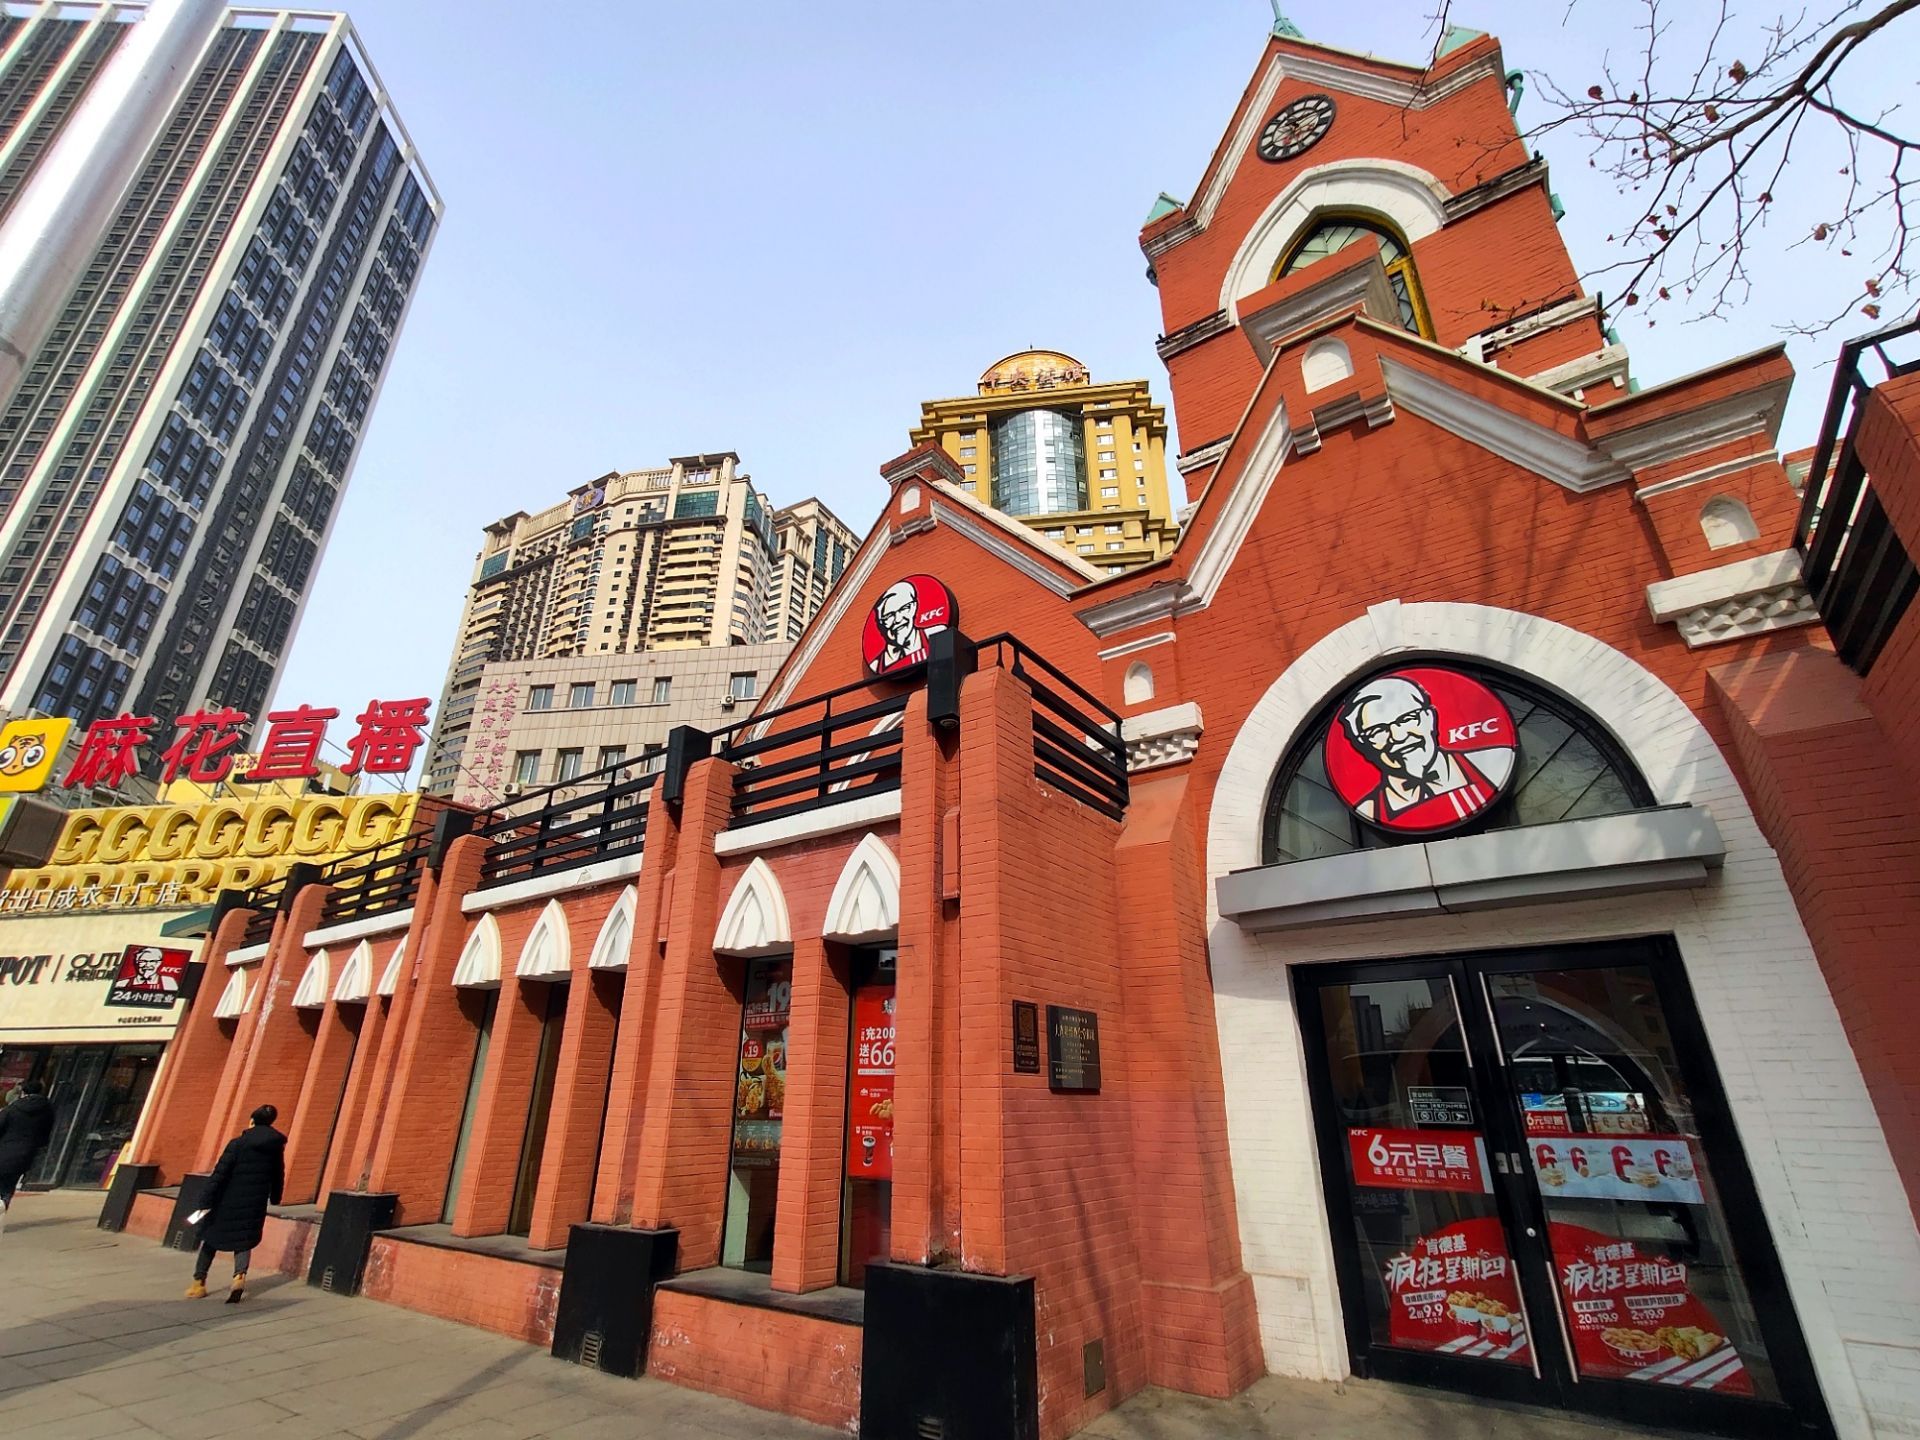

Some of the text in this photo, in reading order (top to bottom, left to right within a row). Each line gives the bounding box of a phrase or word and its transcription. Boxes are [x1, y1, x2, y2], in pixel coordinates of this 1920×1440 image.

[920, 606, 945, 623] KFC
[63, 696, 432, 789] 麻花直播
[1448, 717, 1499, 744] KFC
[0, 954, 52, 985] POT
[160, 966, 182, 974] KFC
[112, 991, 175, 1004] 24小时营业
[1368, 1134, 1469, 1169] 6元早餐
[1425, 1233, 1467, 1256] 肯德基
[1593, 1242, 1635, 1262] 肯德基
[1385, 1252, 1506, 1293] 疯狂星期四
[1563, 1259, 1686, 1297] 疯狂星期四
